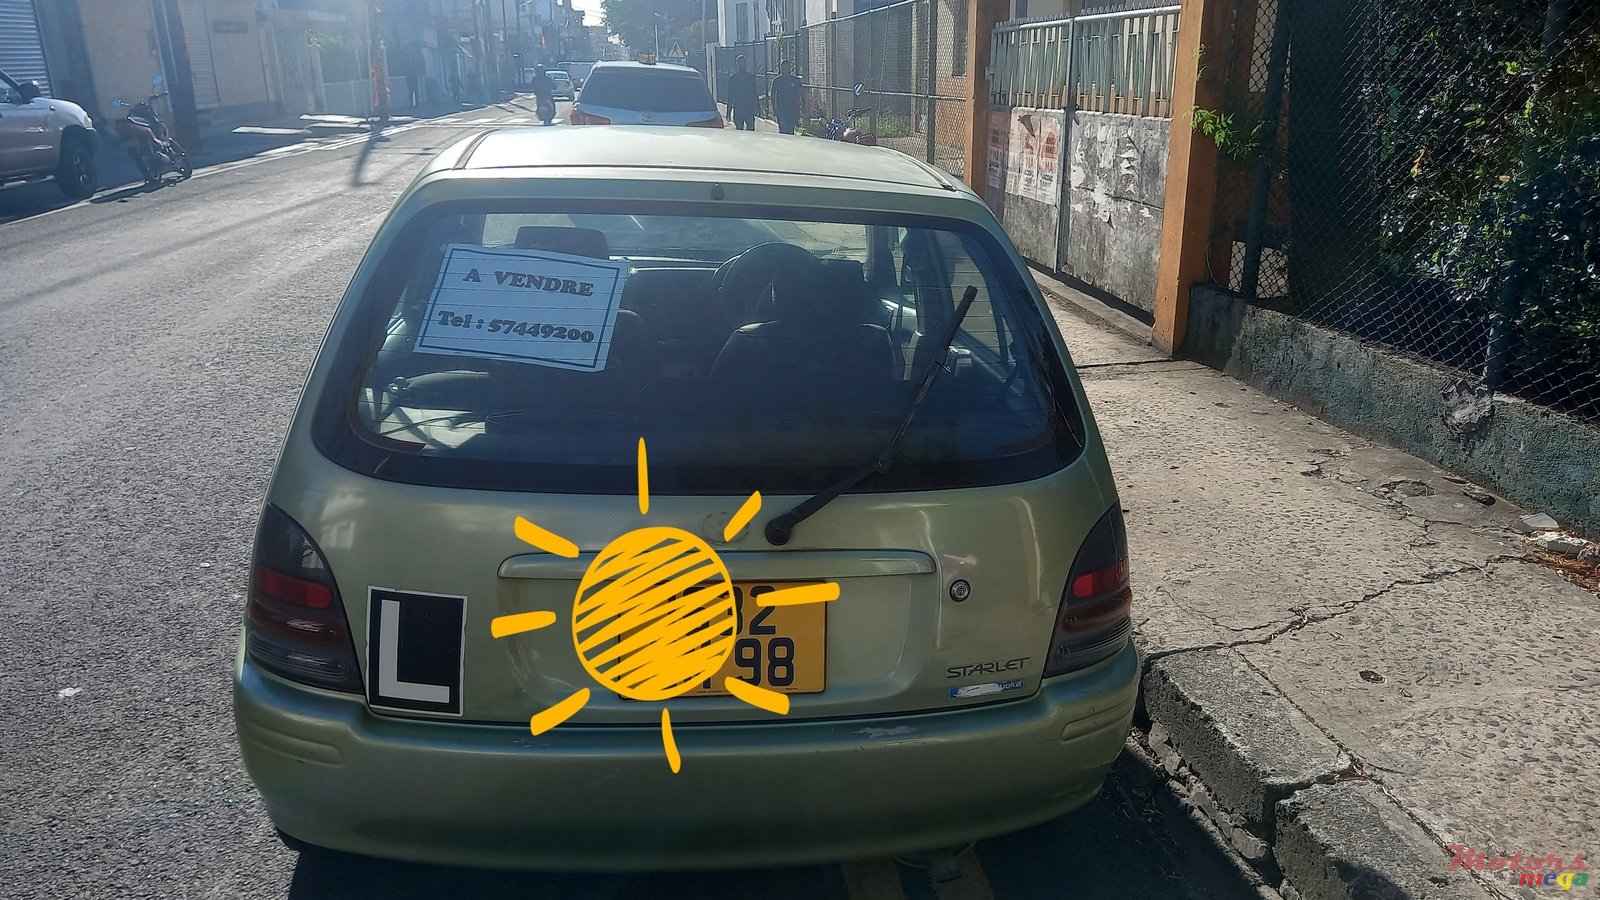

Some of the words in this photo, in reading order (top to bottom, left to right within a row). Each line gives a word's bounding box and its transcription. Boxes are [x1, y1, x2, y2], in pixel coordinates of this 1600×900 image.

[462, 268, 481, 283] A
[494, 270, 594, 297] VENDRE
[487, 319, 595, 343] 57449200
[378, 599, 450, 704] L
[946, 656, 1031, 679] STARLET
